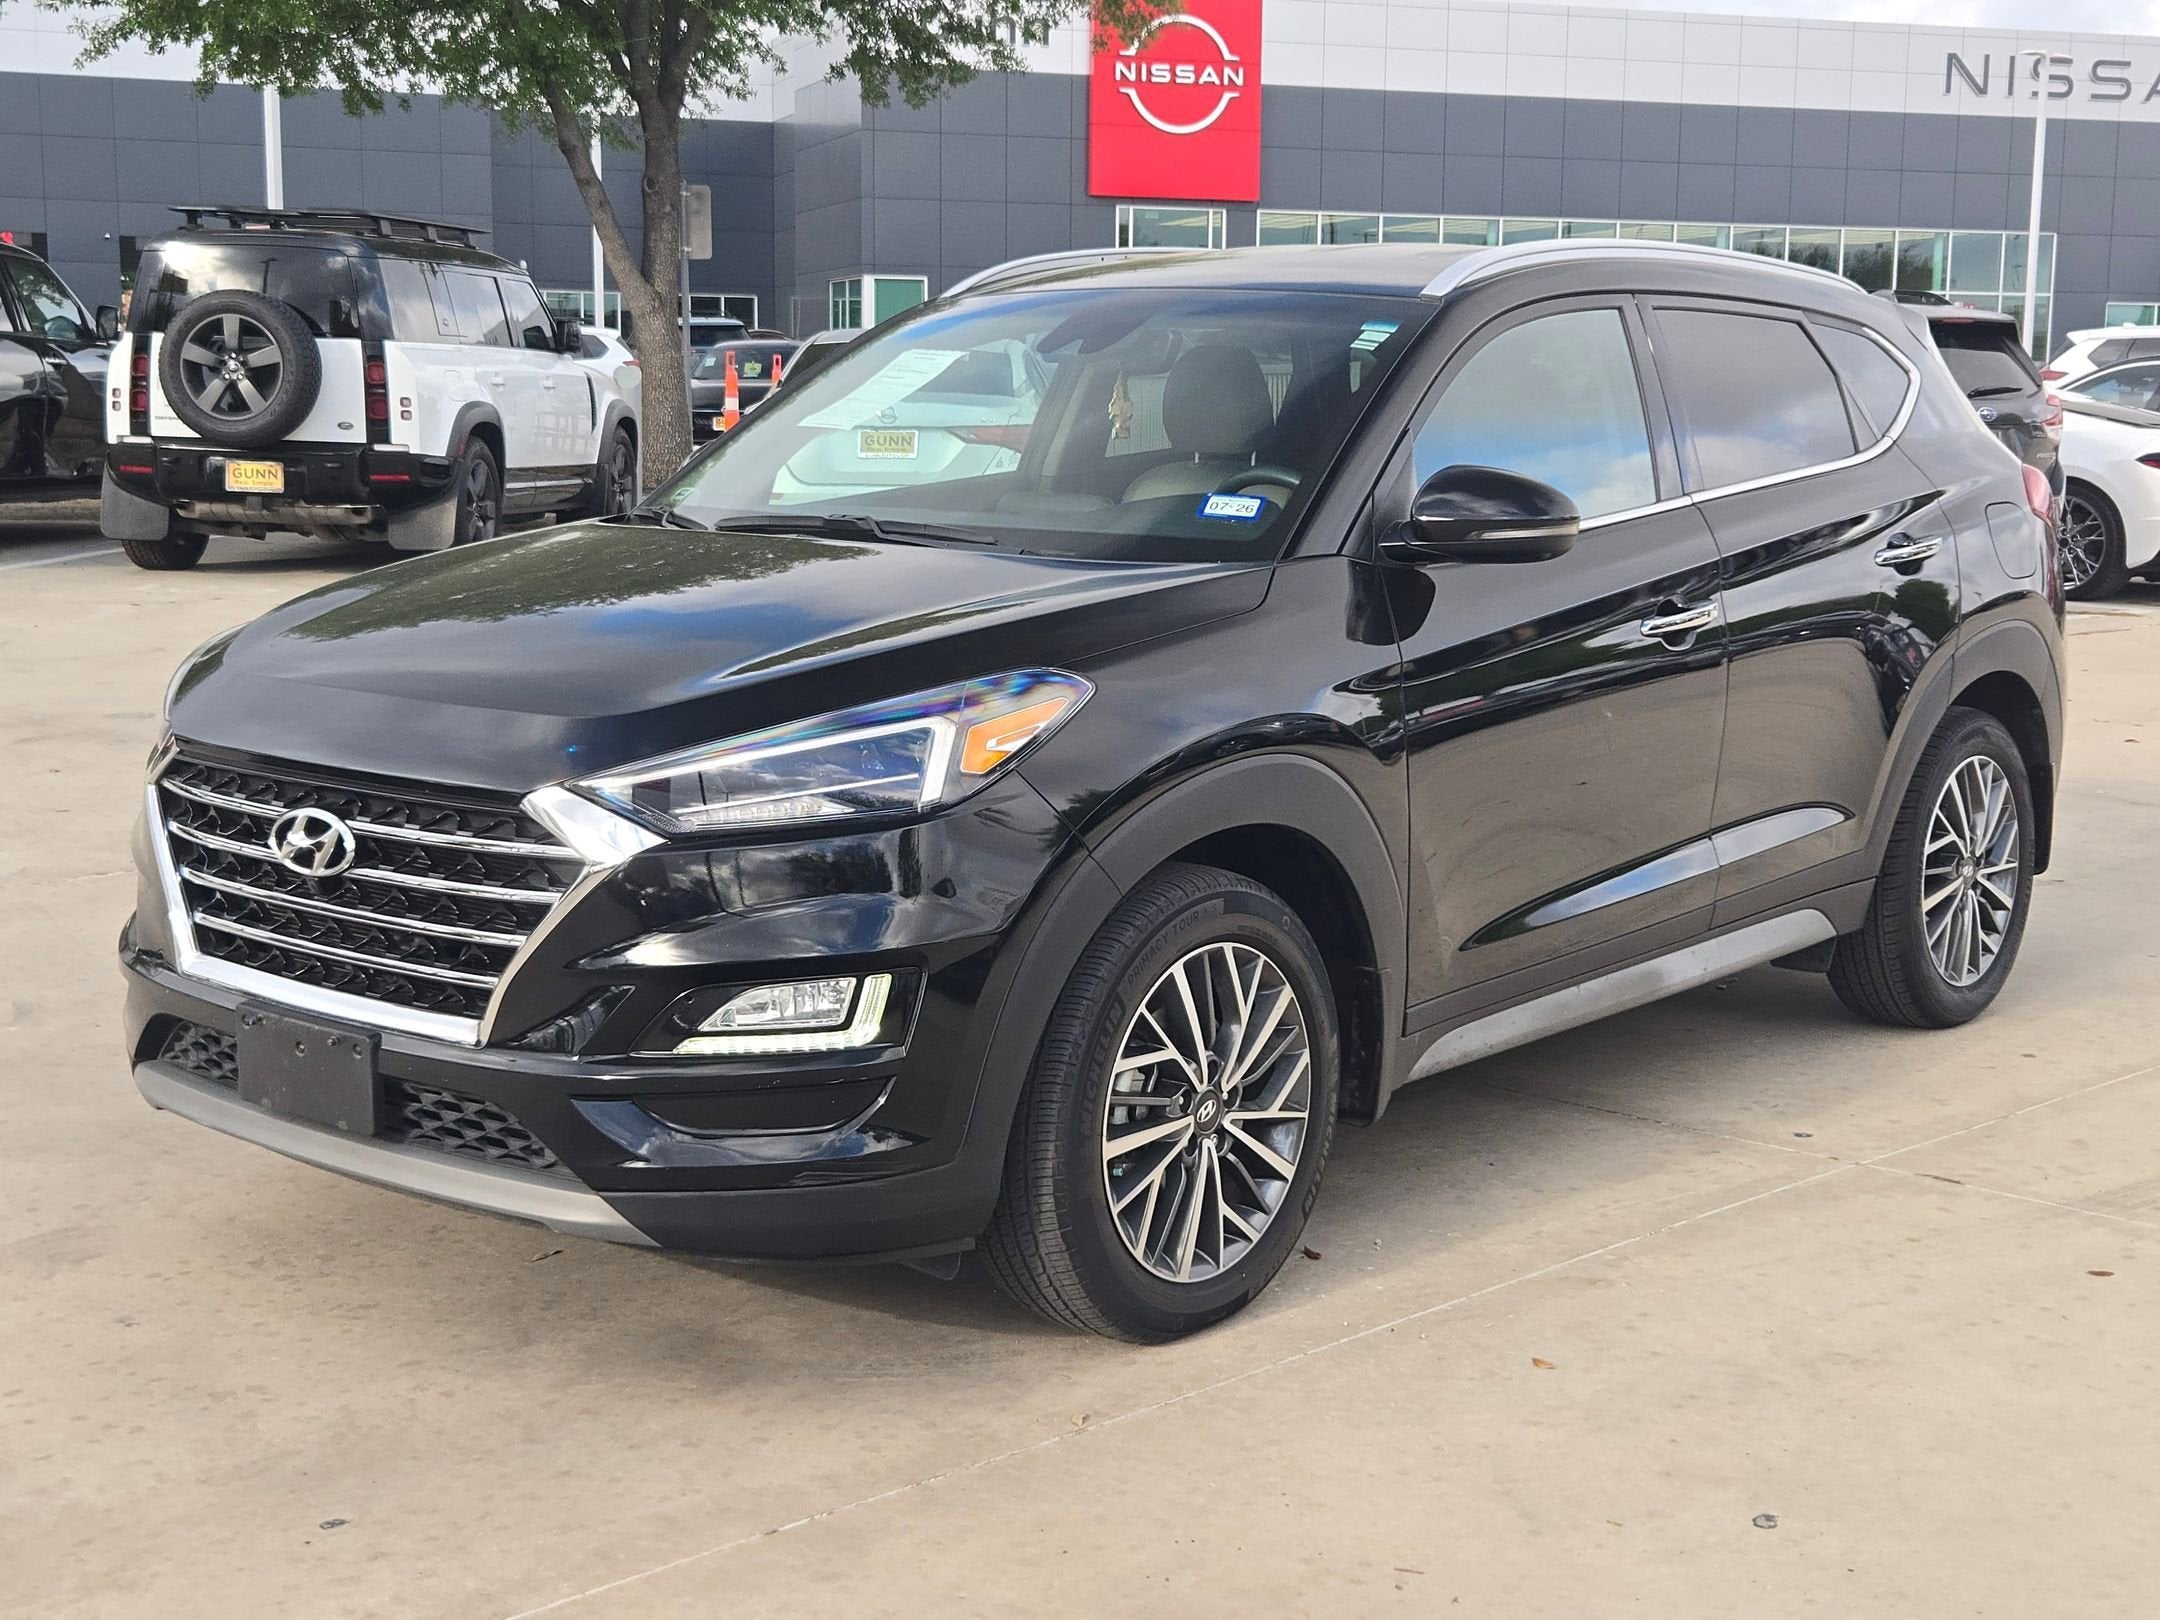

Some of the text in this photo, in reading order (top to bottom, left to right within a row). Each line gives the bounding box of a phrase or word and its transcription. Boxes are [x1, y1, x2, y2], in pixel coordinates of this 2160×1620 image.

[1115, 60, 1243, 86] NISSAN
[865, 435, 912, 447] GUNN
[232, 467, 278, 480] GUNN
[1127, 932, 1169, 987] PRIMACY
[1171, 910, 1200, 933] TOUR
